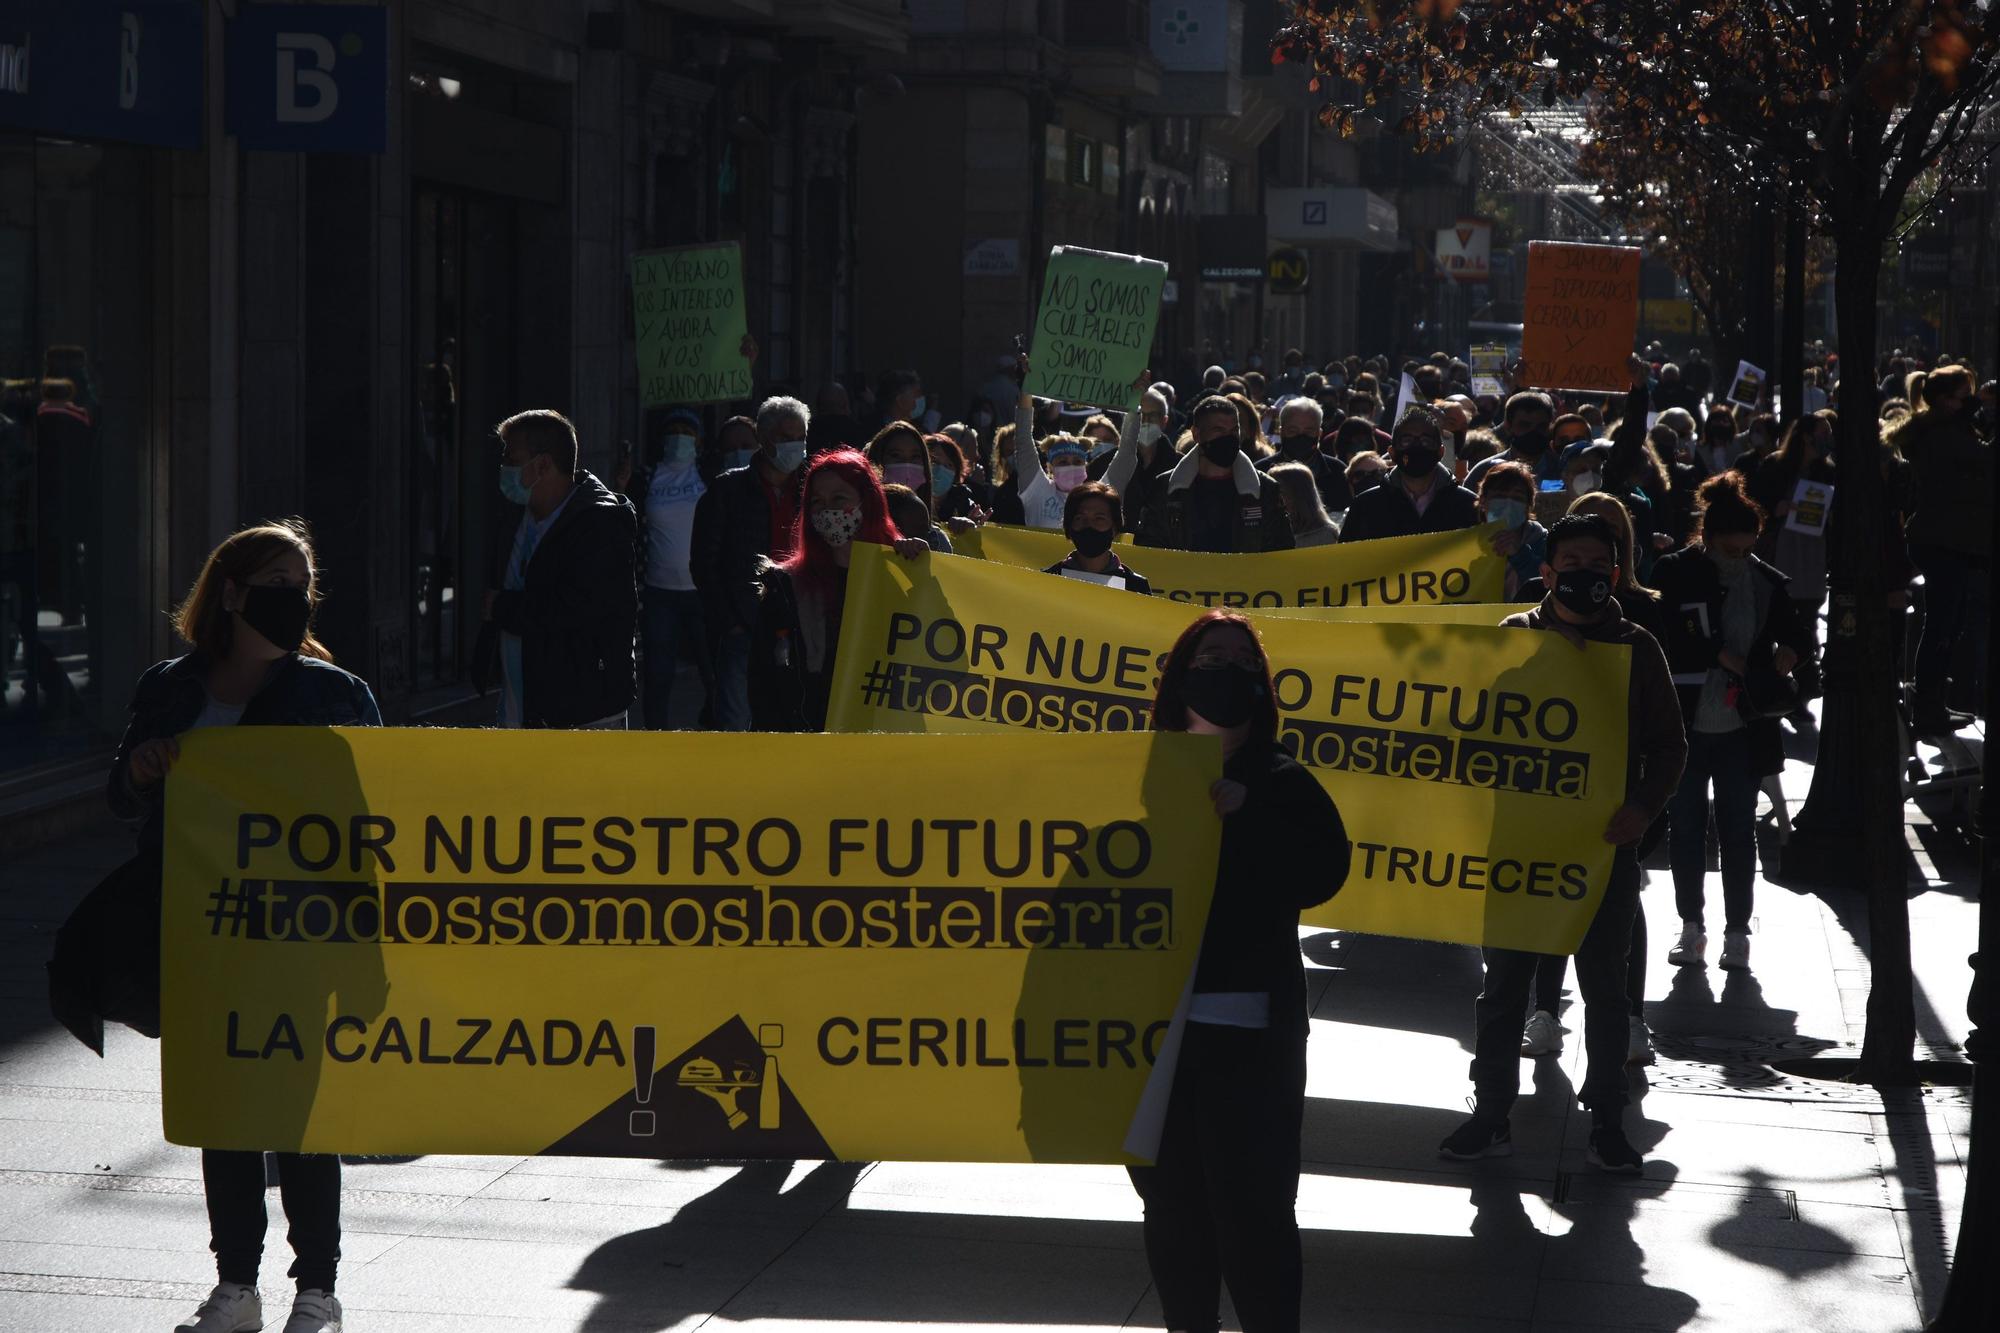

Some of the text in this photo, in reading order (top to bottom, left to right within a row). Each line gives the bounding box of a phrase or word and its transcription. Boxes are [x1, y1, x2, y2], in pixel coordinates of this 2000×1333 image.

[276, 32, 339, 123] B
[662, 253, 730, 284] VERANO
[659, 288, 734, 313] INTERESO
[1046, 273, 1150, 318] NO SOMOS
[657, 315, 717, 342] AHORA
[1043, 308, 1146, 350] CULPABLES
[658, 343, 703, 369] NOS
[1046, 339, 1108, 376] SOMOS
[1297, 567, 1469, 608] FUTURO
[886, 612, 1008, 670] POR
[1330, 674, 1578, 743] FUTURO
[237, 813, 1153, 879] POR NUESTRO FUTURO
[1347, 840, 1588, 901] TRUECES
[205, 877, 1175, 951] #todossomoshosteleria
[225, 1011, 626, 1066] LA CALZADA
